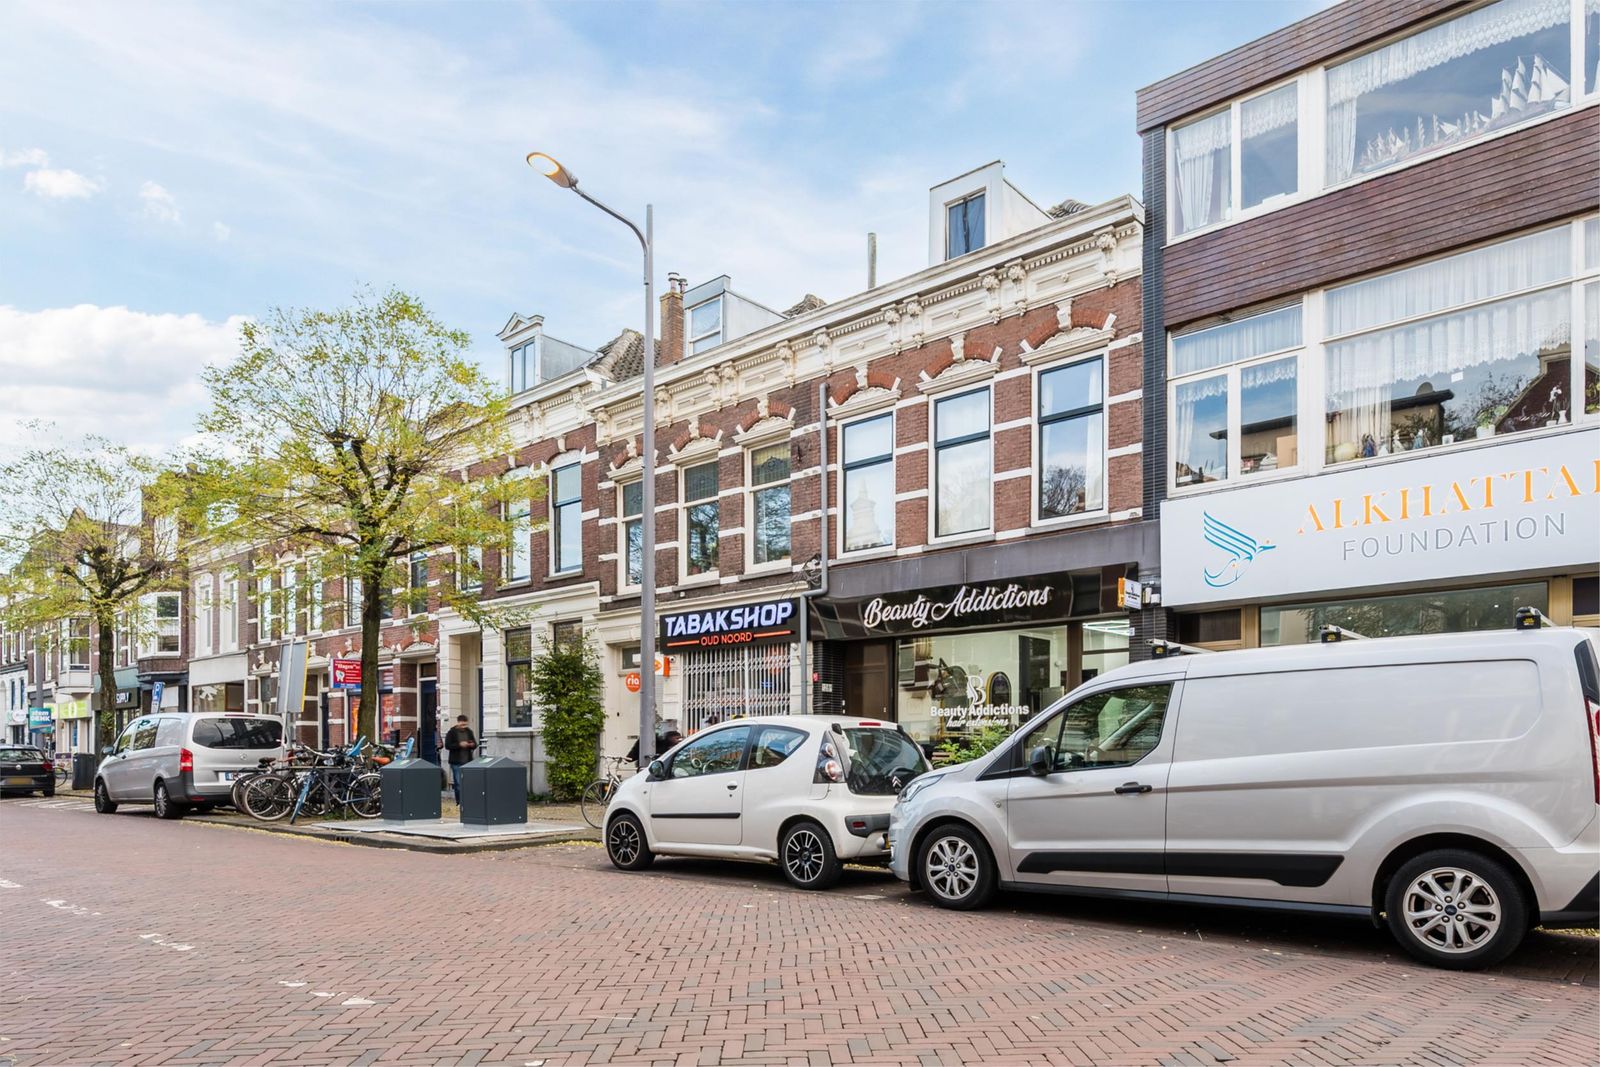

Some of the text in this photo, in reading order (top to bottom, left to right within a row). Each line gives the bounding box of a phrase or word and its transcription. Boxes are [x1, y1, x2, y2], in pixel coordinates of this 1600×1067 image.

[1343, 512, 1567, 562] FOUNDATION
[863, 584, 1050, 628] Beauty Addictions
[700, 632, 753, 646] OUD NOORD
[930, 704, 1030, 718] Beauty Addictions
